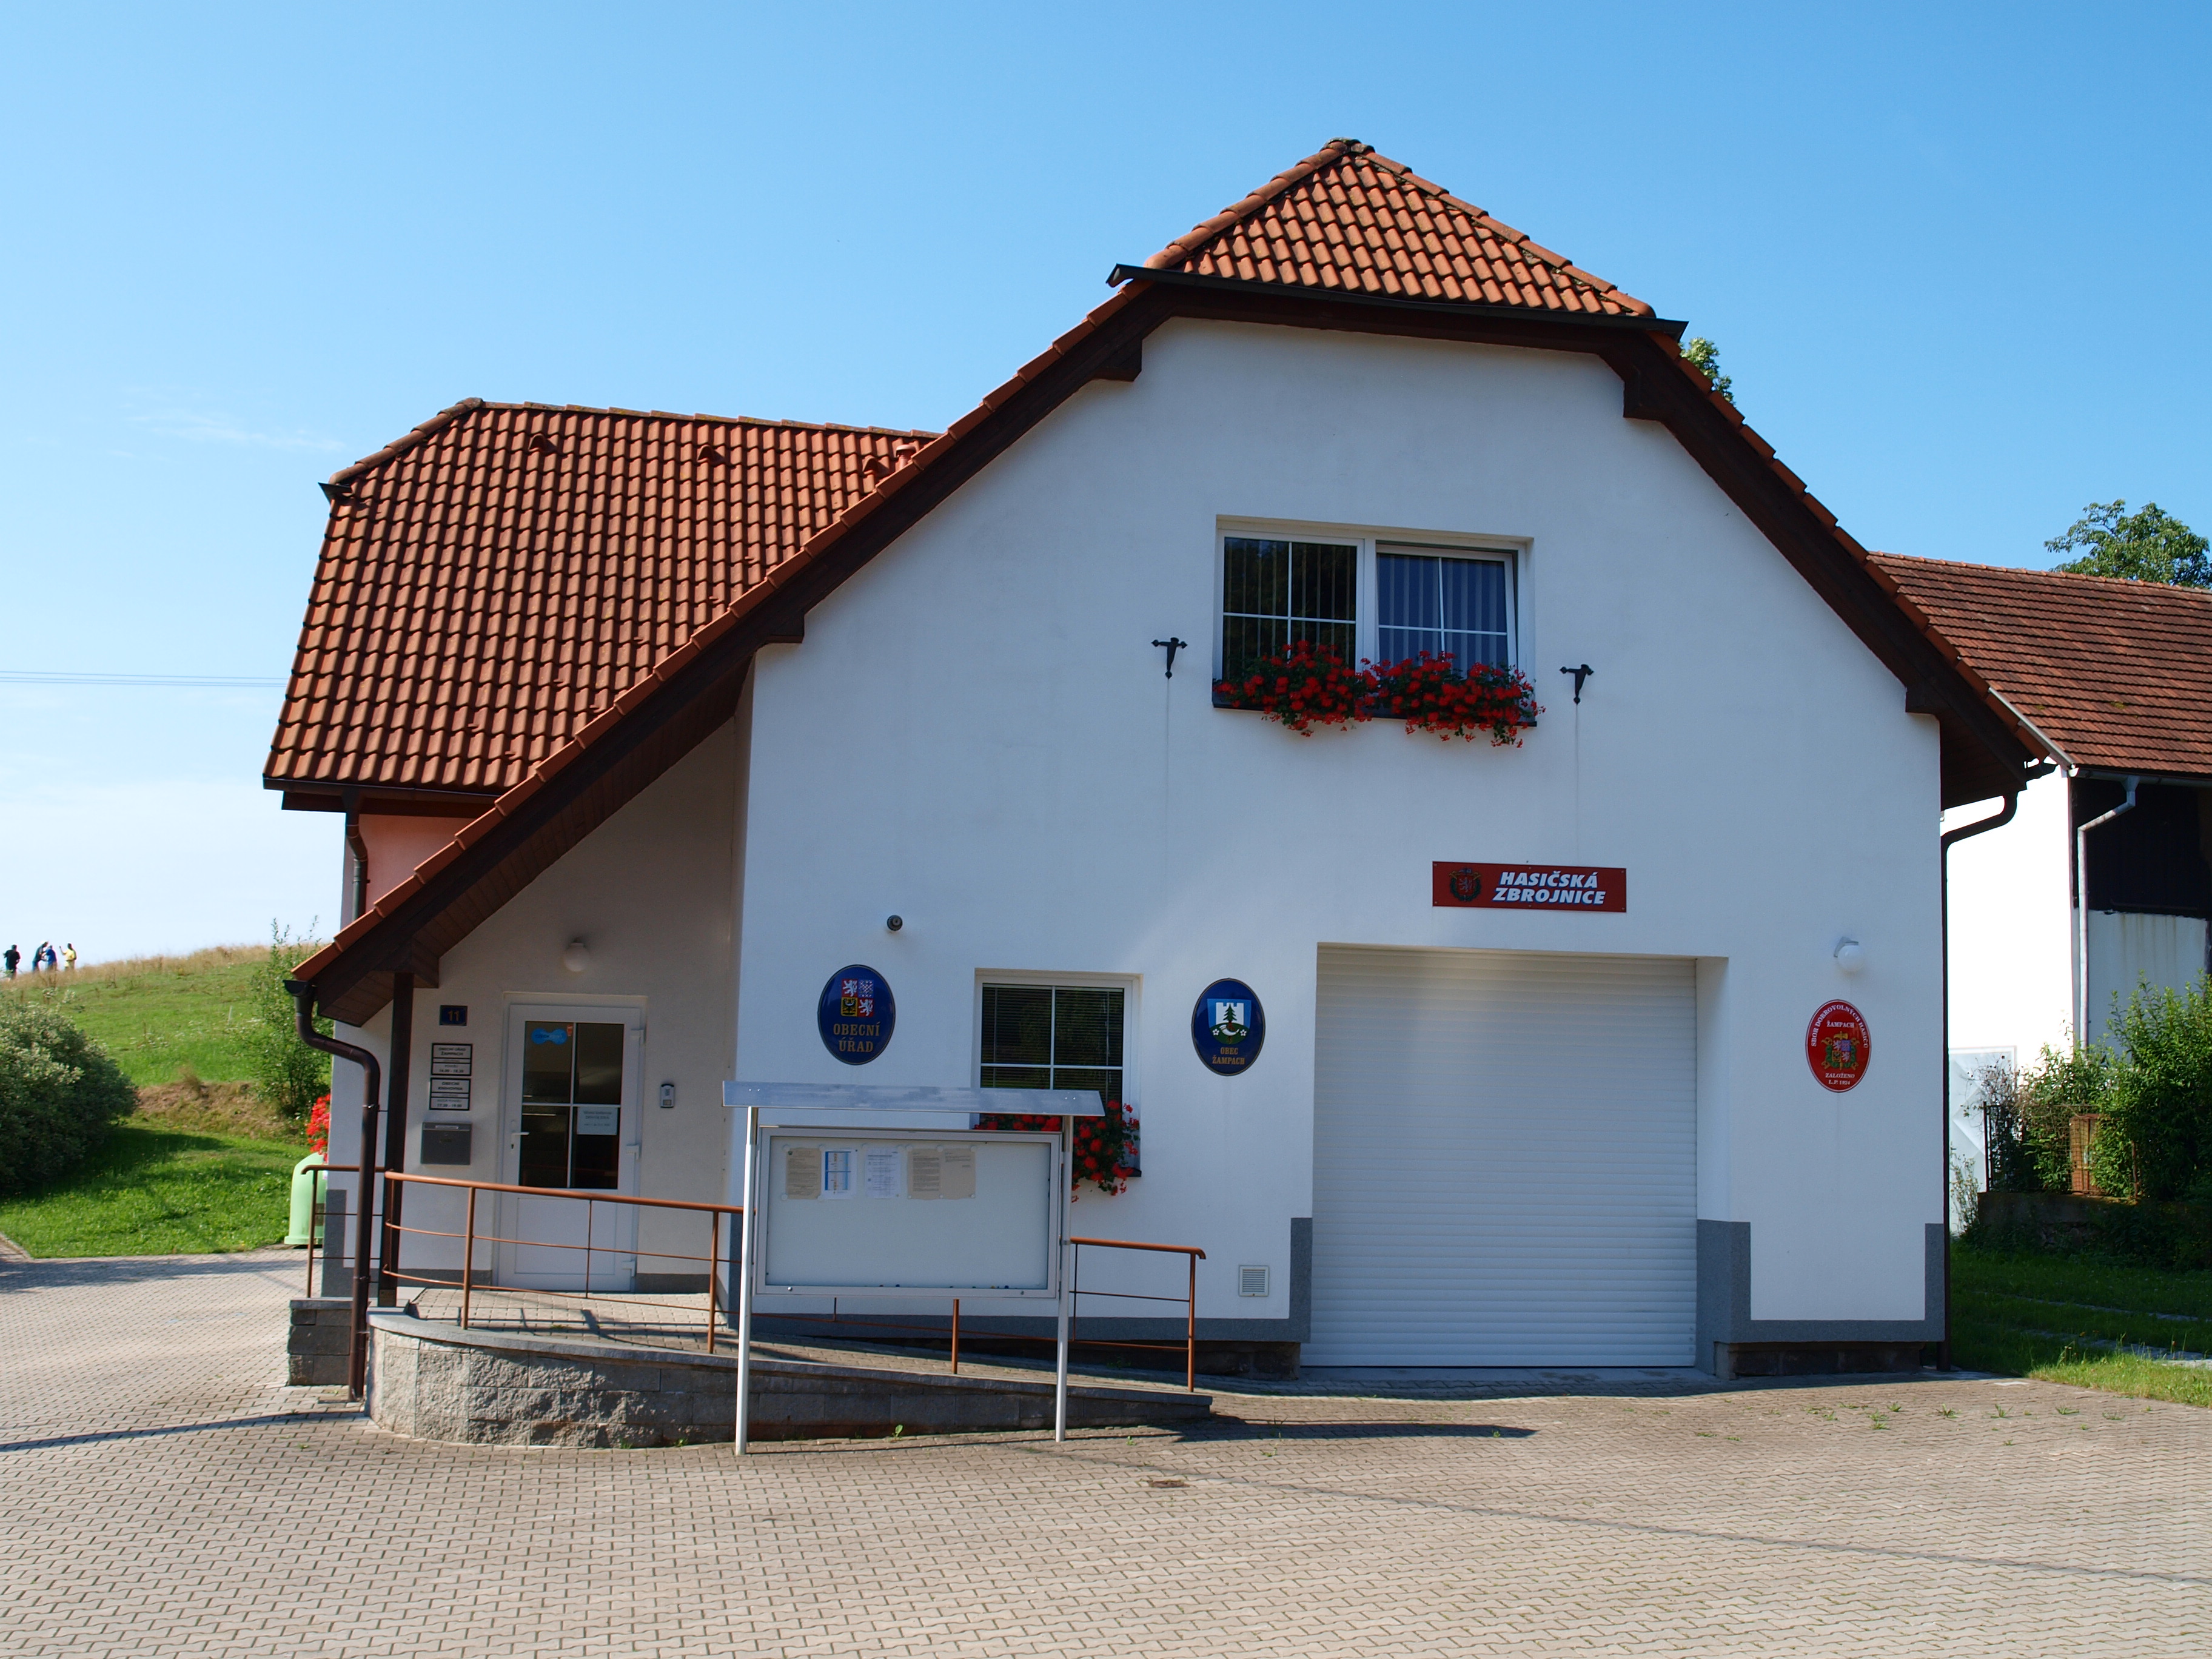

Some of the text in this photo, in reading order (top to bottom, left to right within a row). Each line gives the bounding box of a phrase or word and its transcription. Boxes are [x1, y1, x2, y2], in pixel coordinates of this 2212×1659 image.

[1499, 870, 1598, 888] HASIČSKÁ
[1492, 887, 1606, 905] ZBROJNICE
[447, 1010, 459, 1021] 11
[1815, 1004, 1860, 1027] DOBROVOLNÝCH
[833, 1022, 881, 1036] OBECNÍ
[1826, 1020, 1855, 1028] ŽAMPACH
[838, 1037, 874, 1053] ÚŘAD
[1220, 1047, 1239, 1055] OBEC
[1212, 1054, 1245, 1065] ŽAMPACH
